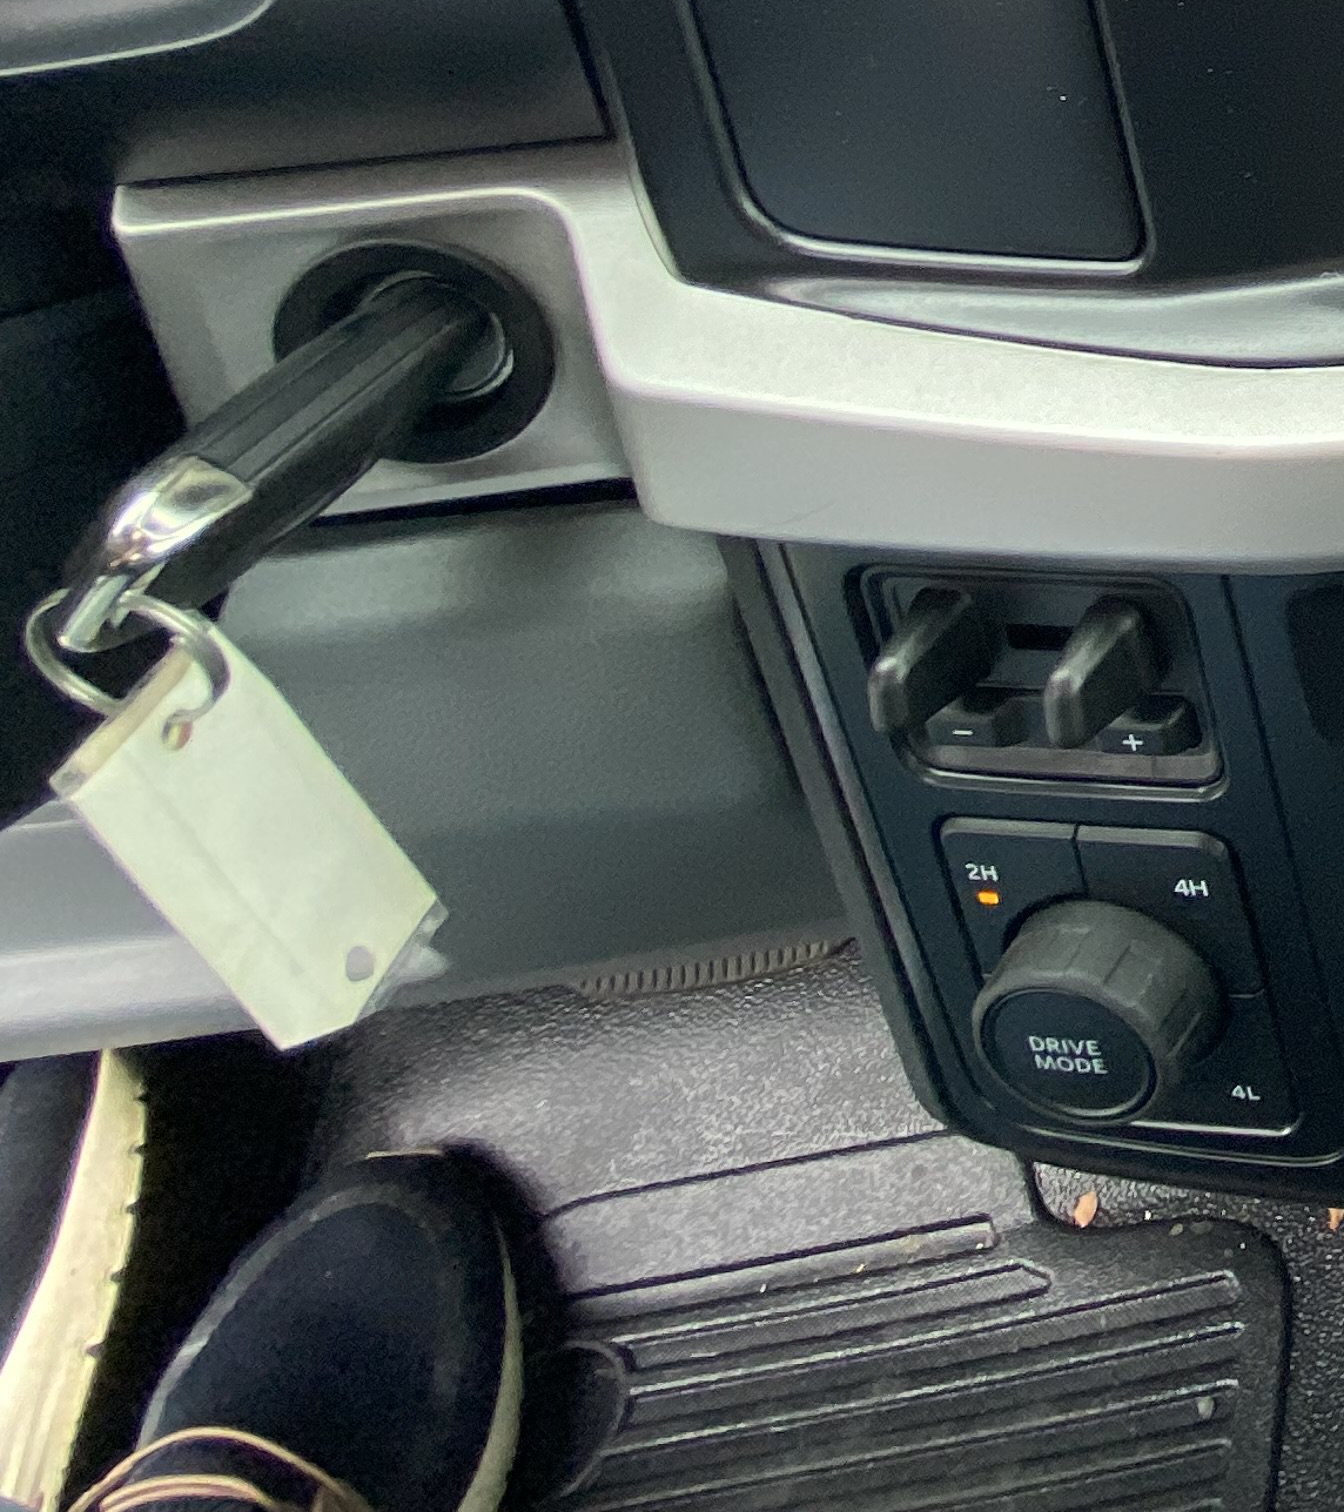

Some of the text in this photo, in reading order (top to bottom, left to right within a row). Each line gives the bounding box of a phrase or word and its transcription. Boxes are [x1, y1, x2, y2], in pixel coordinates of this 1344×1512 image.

[965, 863, 998, 883] 2H
[1174, 878, 1209, 899] 4H
[1028, 1035, 1103, 1058] DRIVE
[1035, 1054, 1109, 1076] MODE
[1231, 1085, 1261, 1101] 4L
